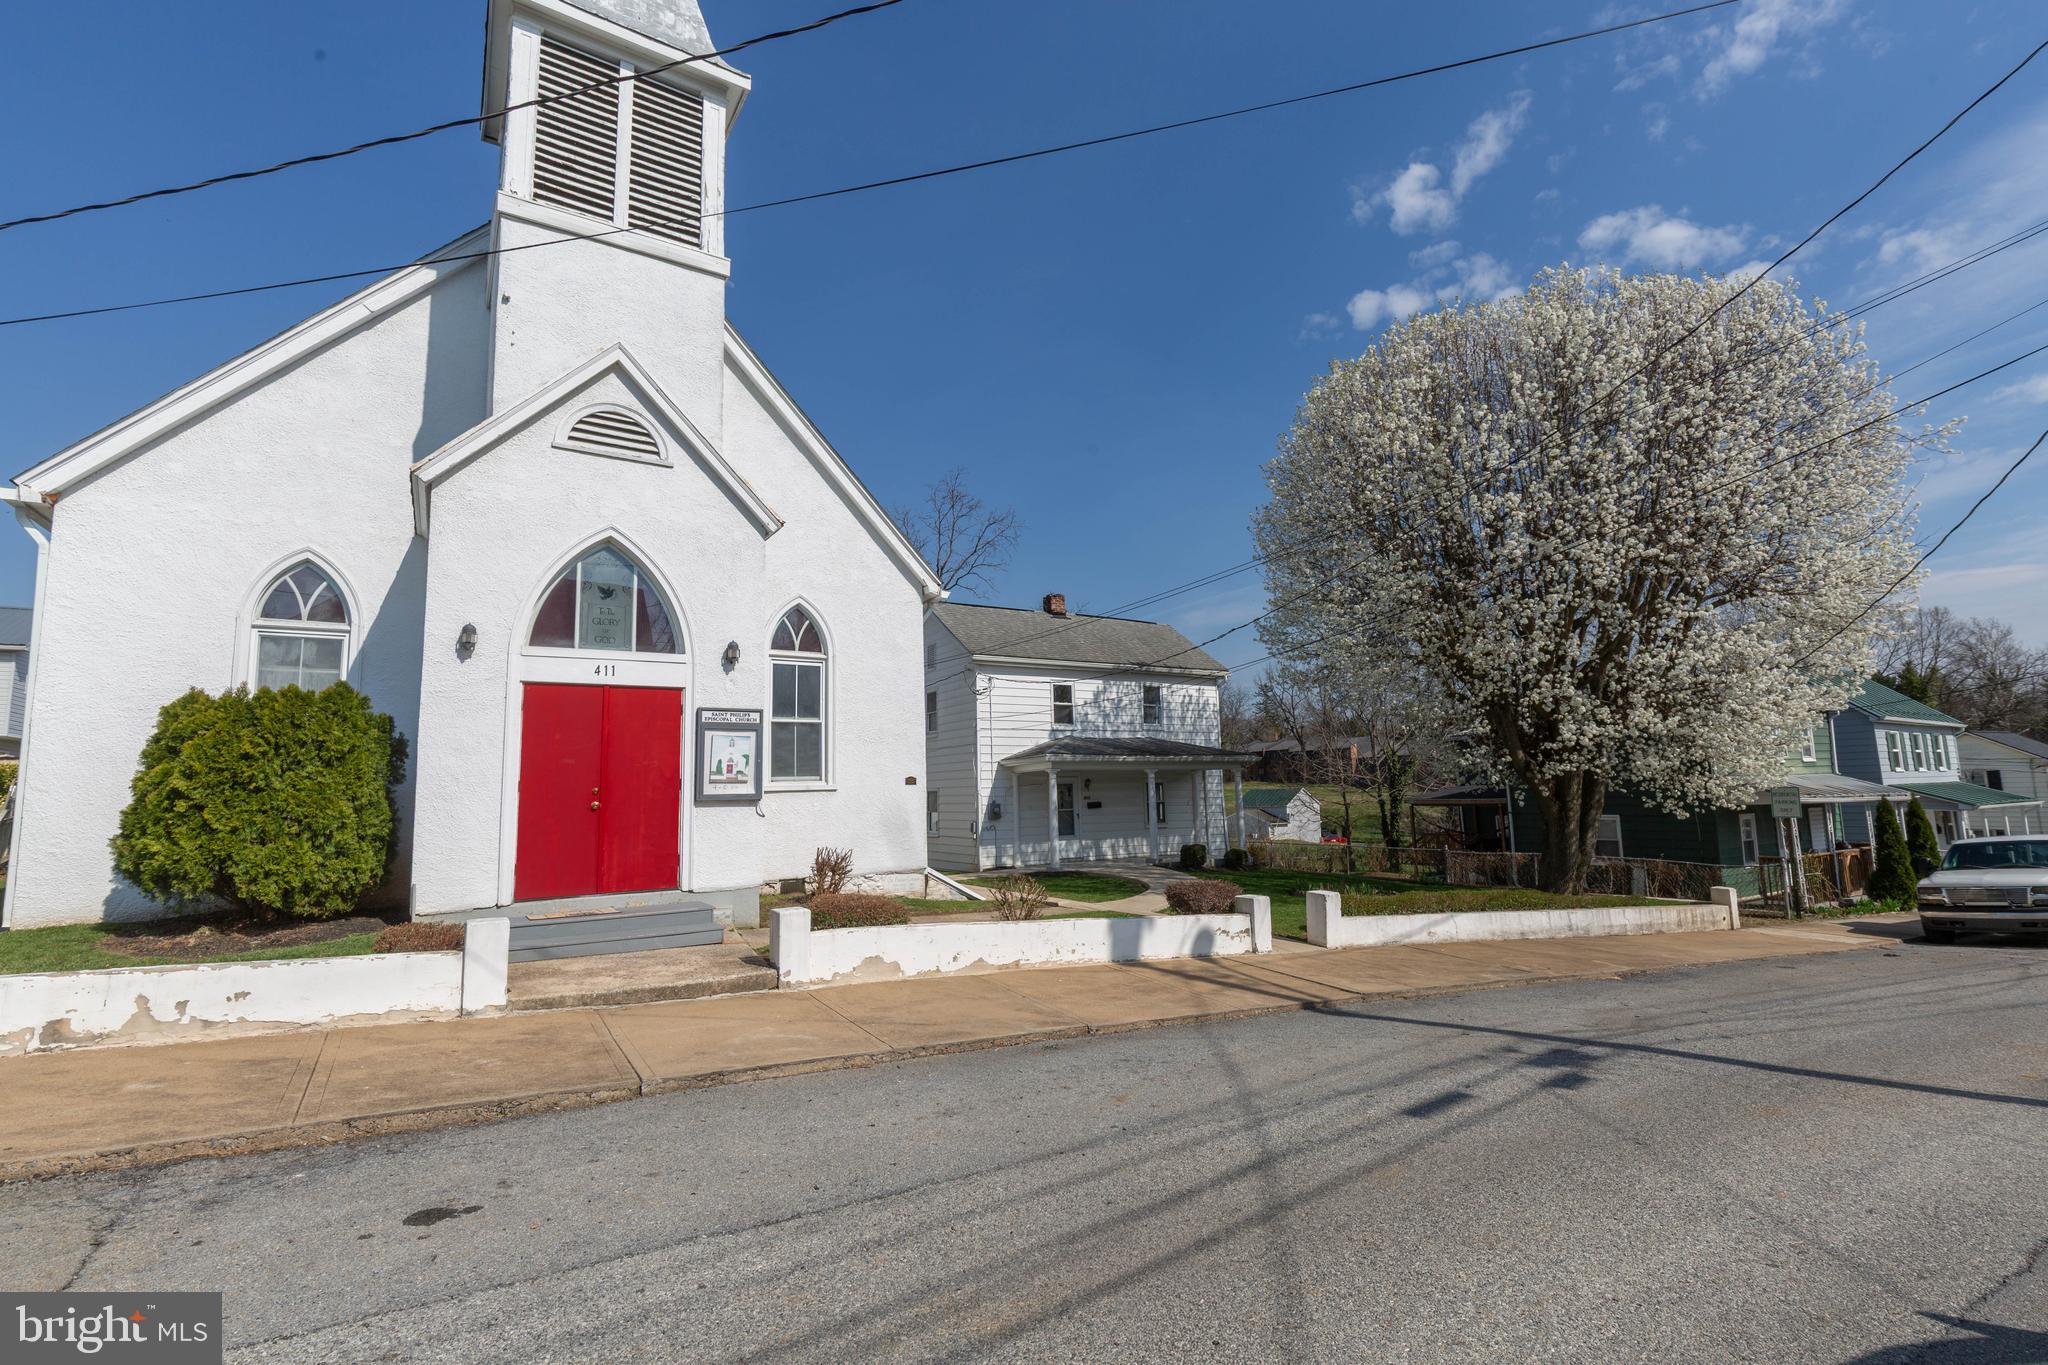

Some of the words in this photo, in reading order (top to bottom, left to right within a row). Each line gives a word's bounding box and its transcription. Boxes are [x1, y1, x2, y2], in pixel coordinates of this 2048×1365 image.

[592, 617, 620, 626] GLORY
[594, 635, 616, 644] GOD
[594, 665, 615, 676] 411
